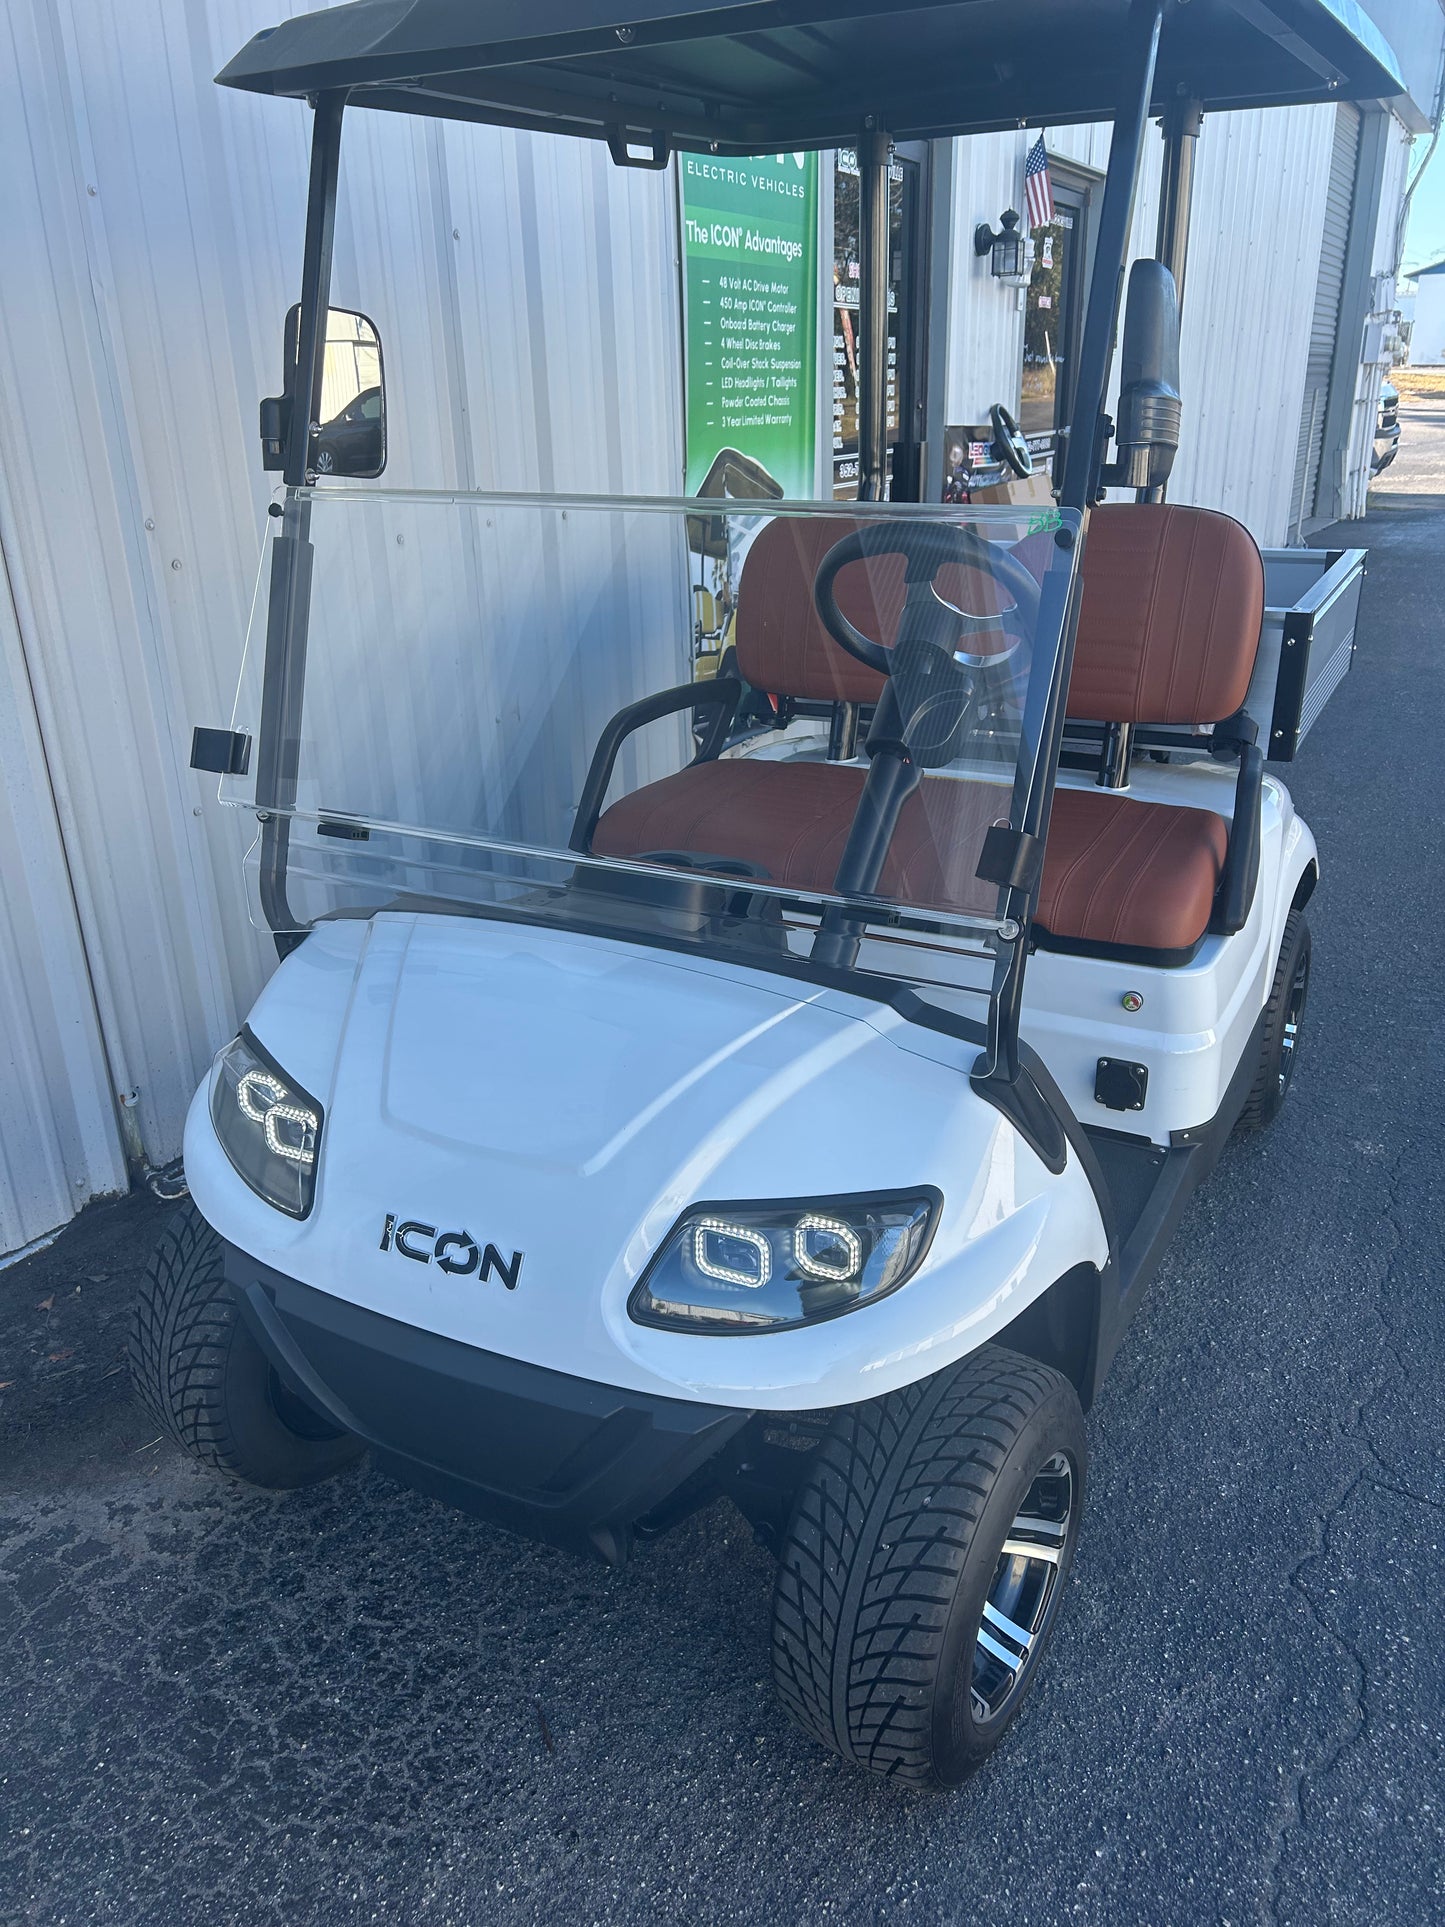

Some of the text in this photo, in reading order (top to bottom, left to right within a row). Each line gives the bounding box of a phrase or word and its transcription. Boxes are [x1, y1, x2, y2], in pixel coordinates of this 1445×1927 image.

[687, 160, 747, 186] ELECTRIC
[751, 175, 805, 198] VEHICLES
[686, 220, 708, 244] The
[744, 229, 803, 262] Advantages
[719, 276, 789, 294] 48 Volt AC Drive Motor
[719, 296, 733, 310] 450
[733, 297, 748, 313] Amp
[767, 300, 797, 314] Controller
[720, 316, 796, 335] Onboard Battery Charger
[721, 337, 781, 351] 4 Wheel Disc Brakes
[720, 357, 802, 372] Coil-Over Shock Suspension
[721, 376, 734, 389] LED
[734, 376, 765, 391] Headlights
[771, 376, 797, 391] Taillights
[721, 394, 790, 408] Powder Coated Chassis
[722, 413, 792, 428] 3 Year Limited Warranty
[379, 1213, 525, 1291] ICON
